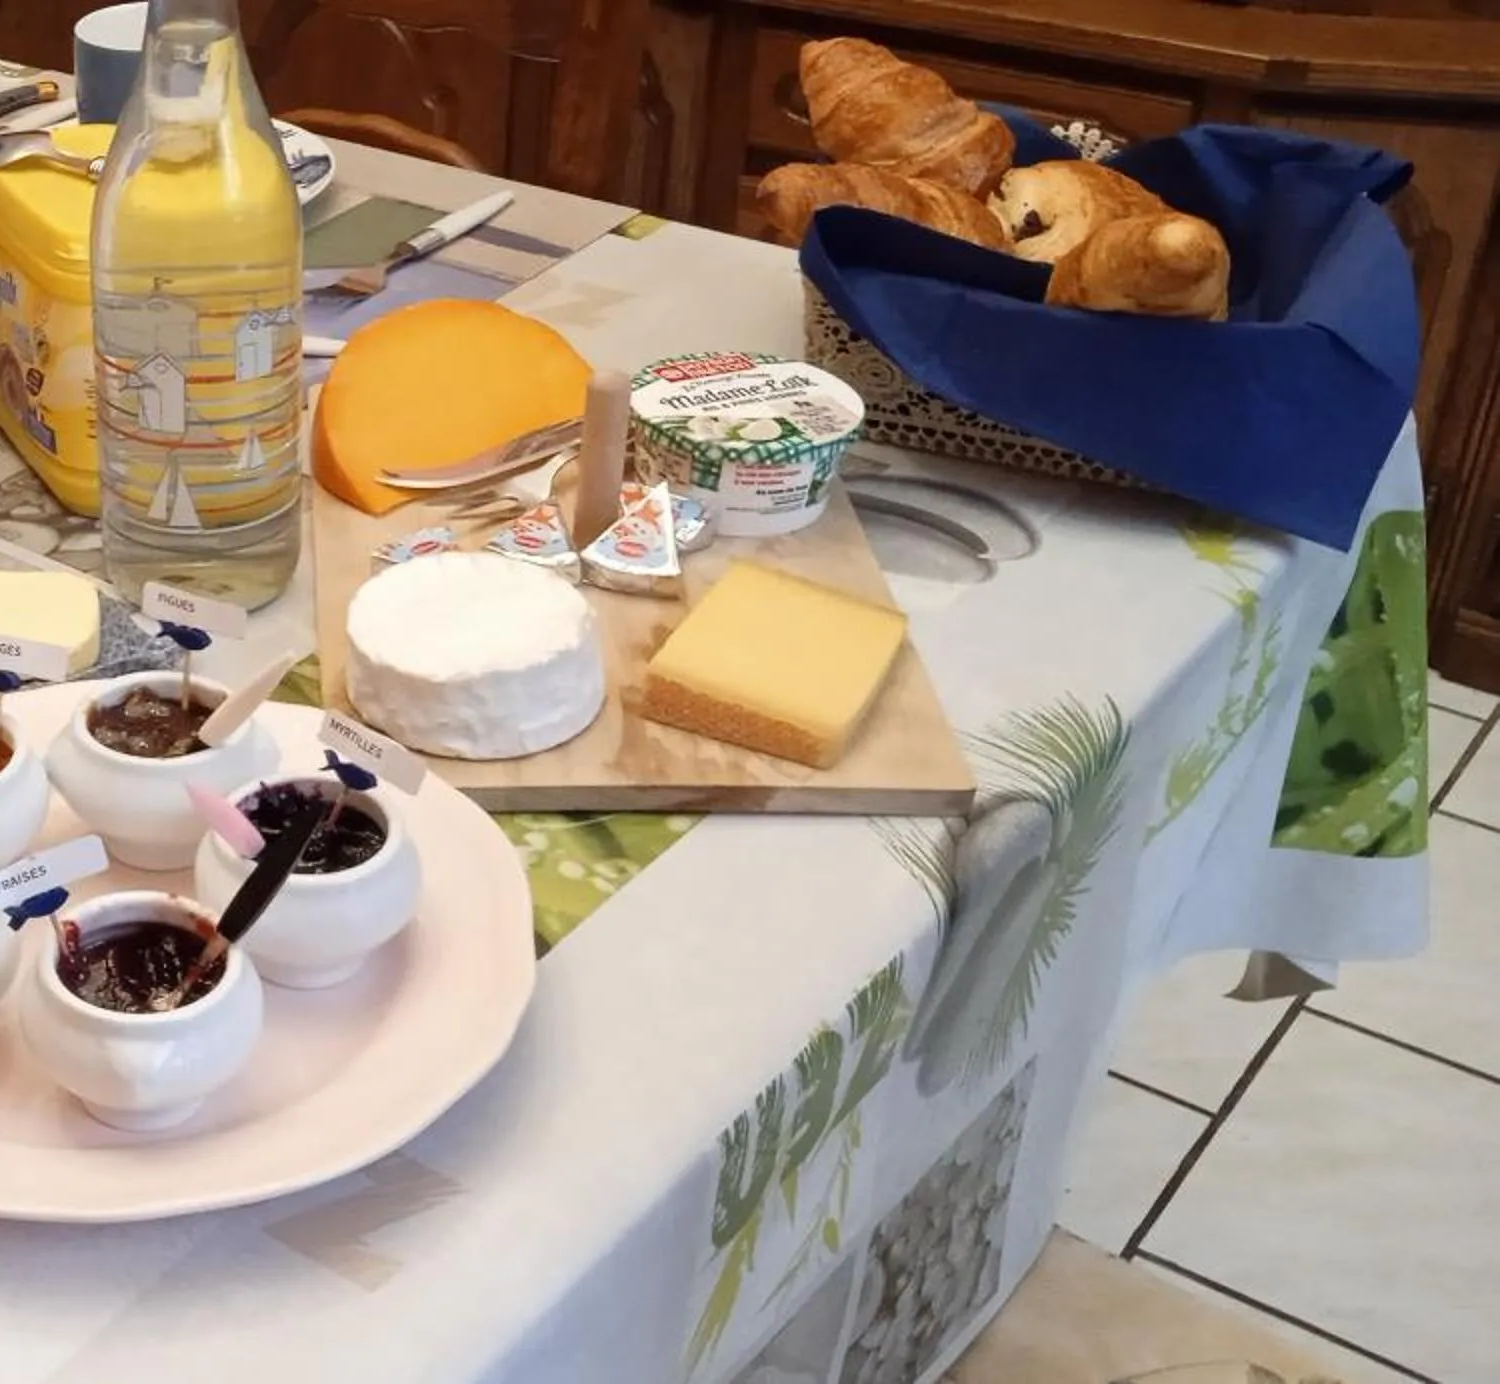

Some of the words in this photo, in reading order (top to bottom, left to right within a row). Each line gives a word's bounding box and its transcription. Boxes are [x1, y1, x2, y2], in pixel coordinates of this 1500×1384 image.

[659, 384, 764, 410] Madame
[157, 592, 196, 613] FIGUES
[328, 718, 383, 760] MYRTILLES
